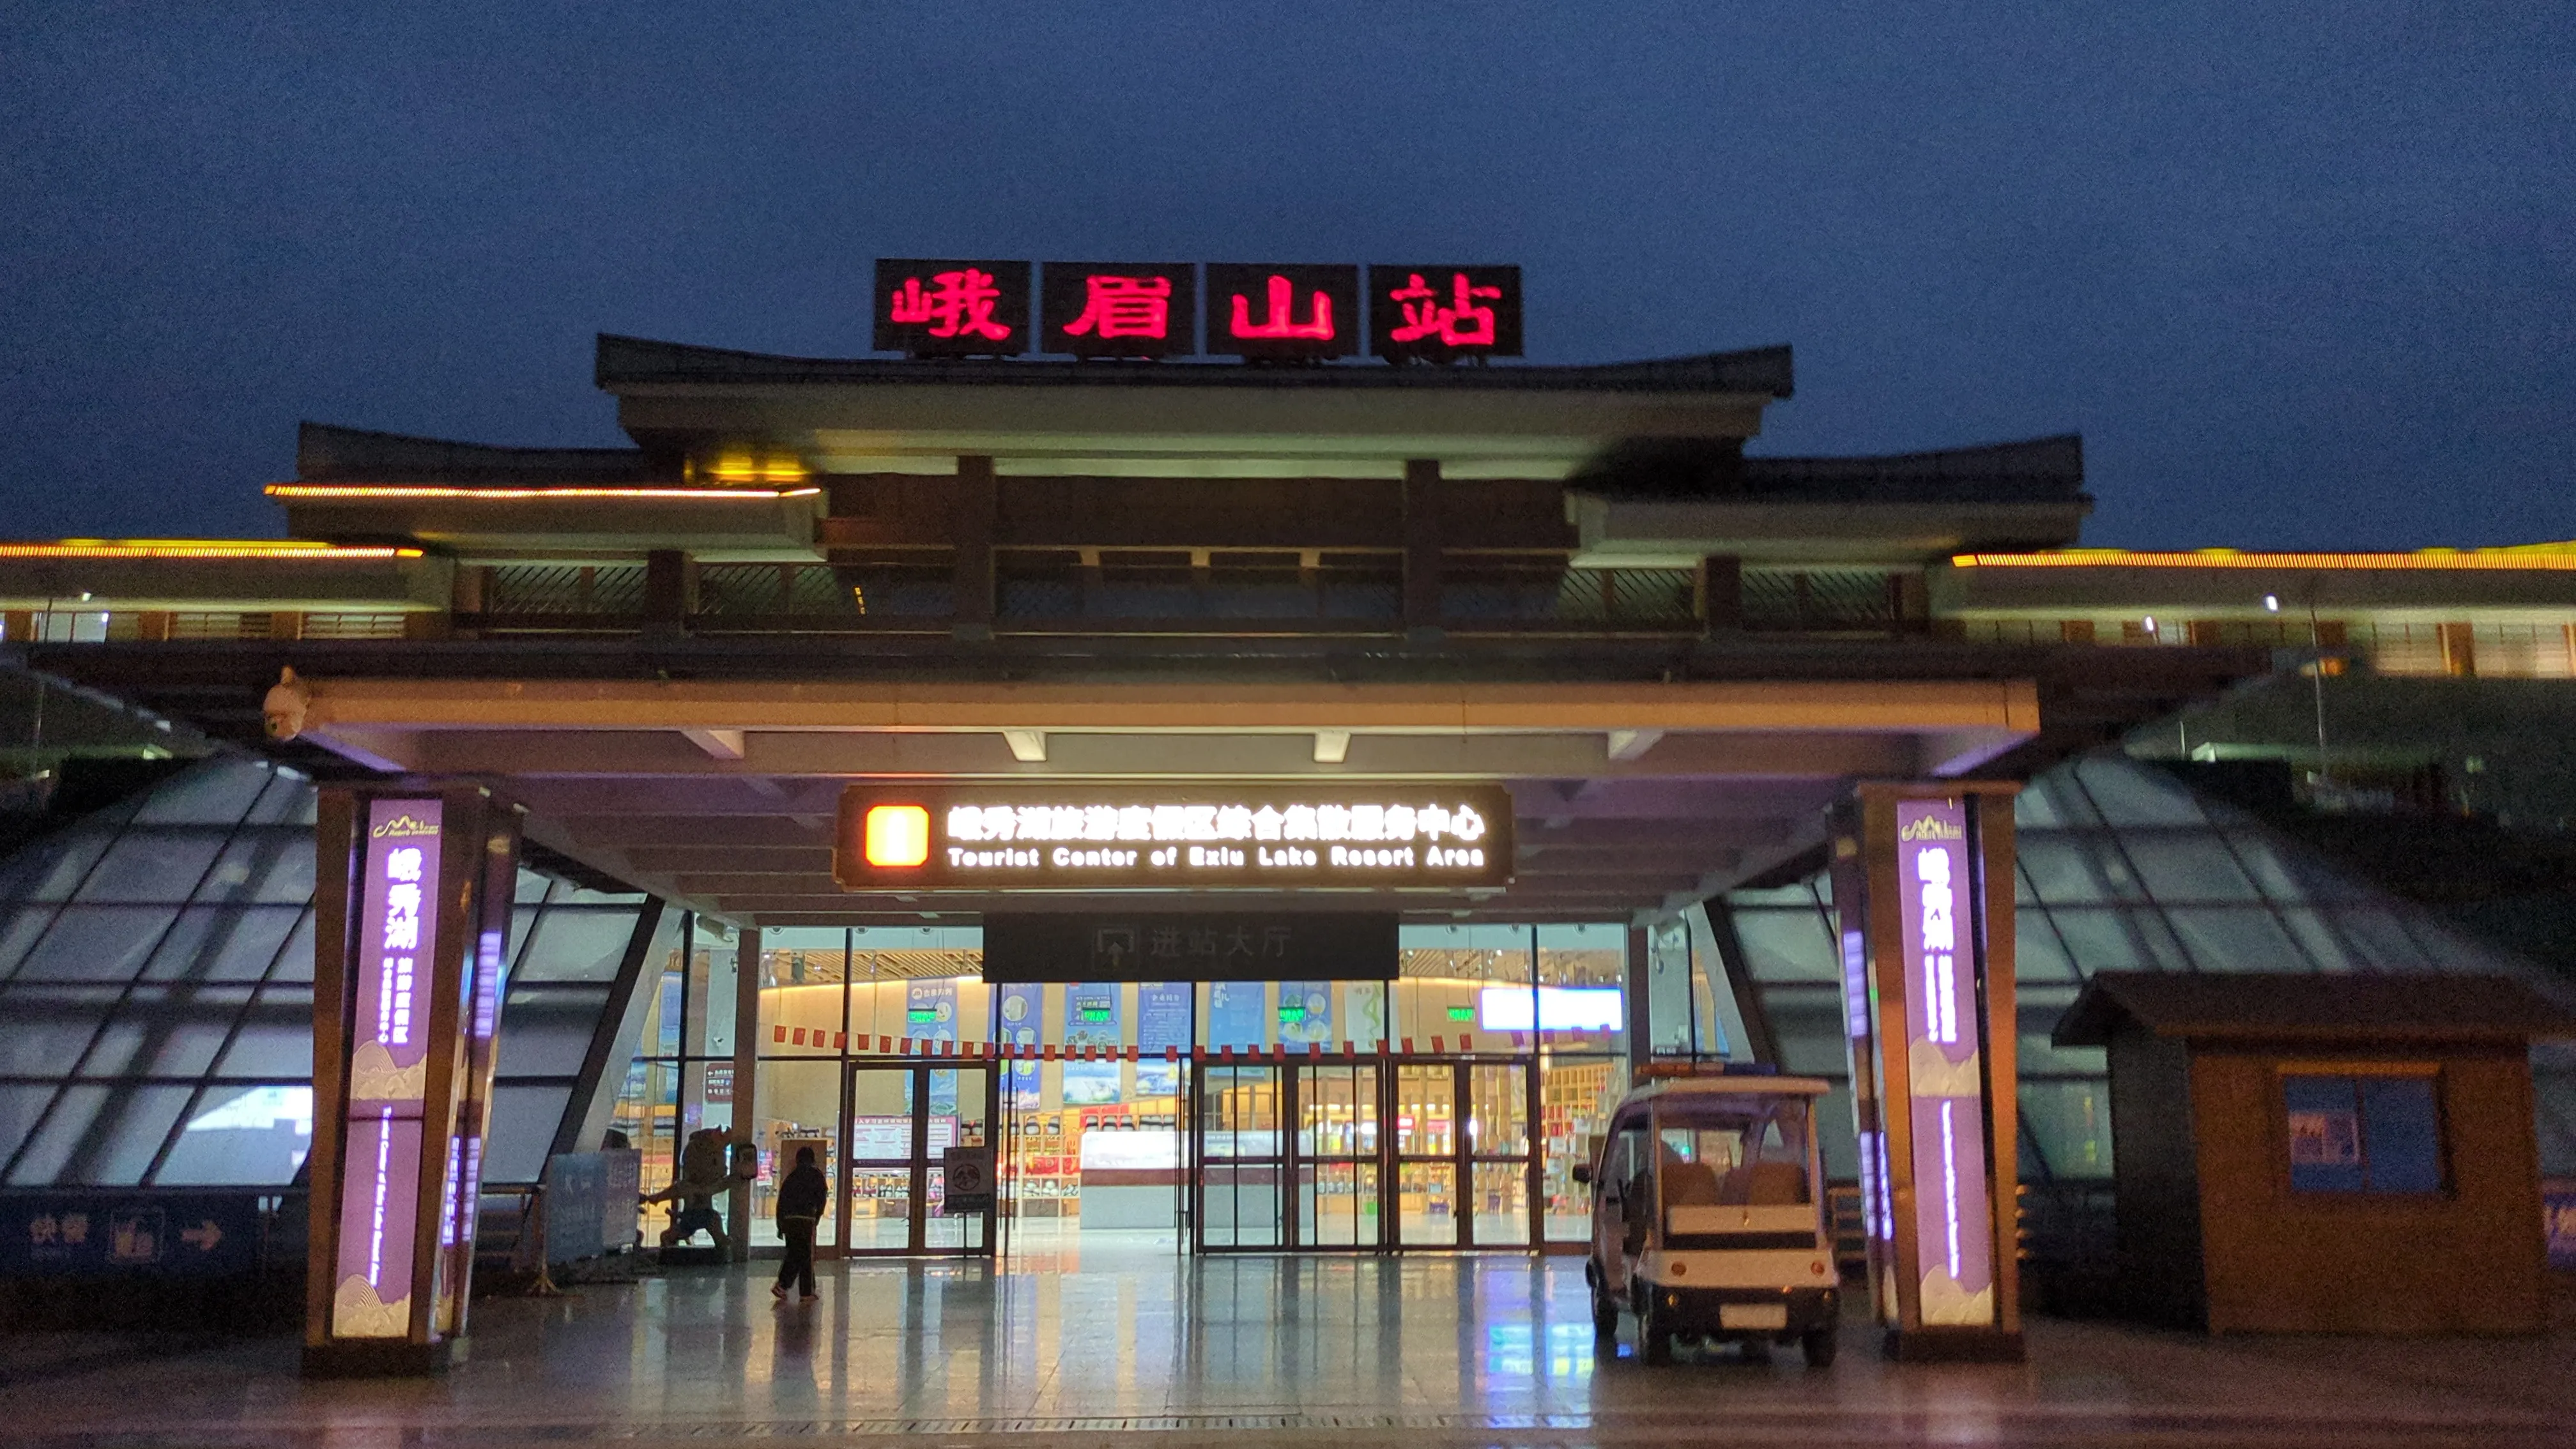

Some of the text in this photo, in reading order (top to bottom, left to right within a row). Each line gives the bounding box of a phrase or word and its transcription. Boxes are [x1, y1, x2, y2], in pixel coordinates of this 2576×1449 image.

[891, 269, 1501, 346] 峨眉山站
[948, 848, 1039, 866] Tourist
[1053, 848, 1137, 866] Center
[1151, 847, 1177, 866] of
[1259, 847, 1316, 865] Lake
[1331, 847, 1413, 866] Resort
[1427, 846, 1483, 866] Area
[1149, 925, 1291, 958] 进站大厅
